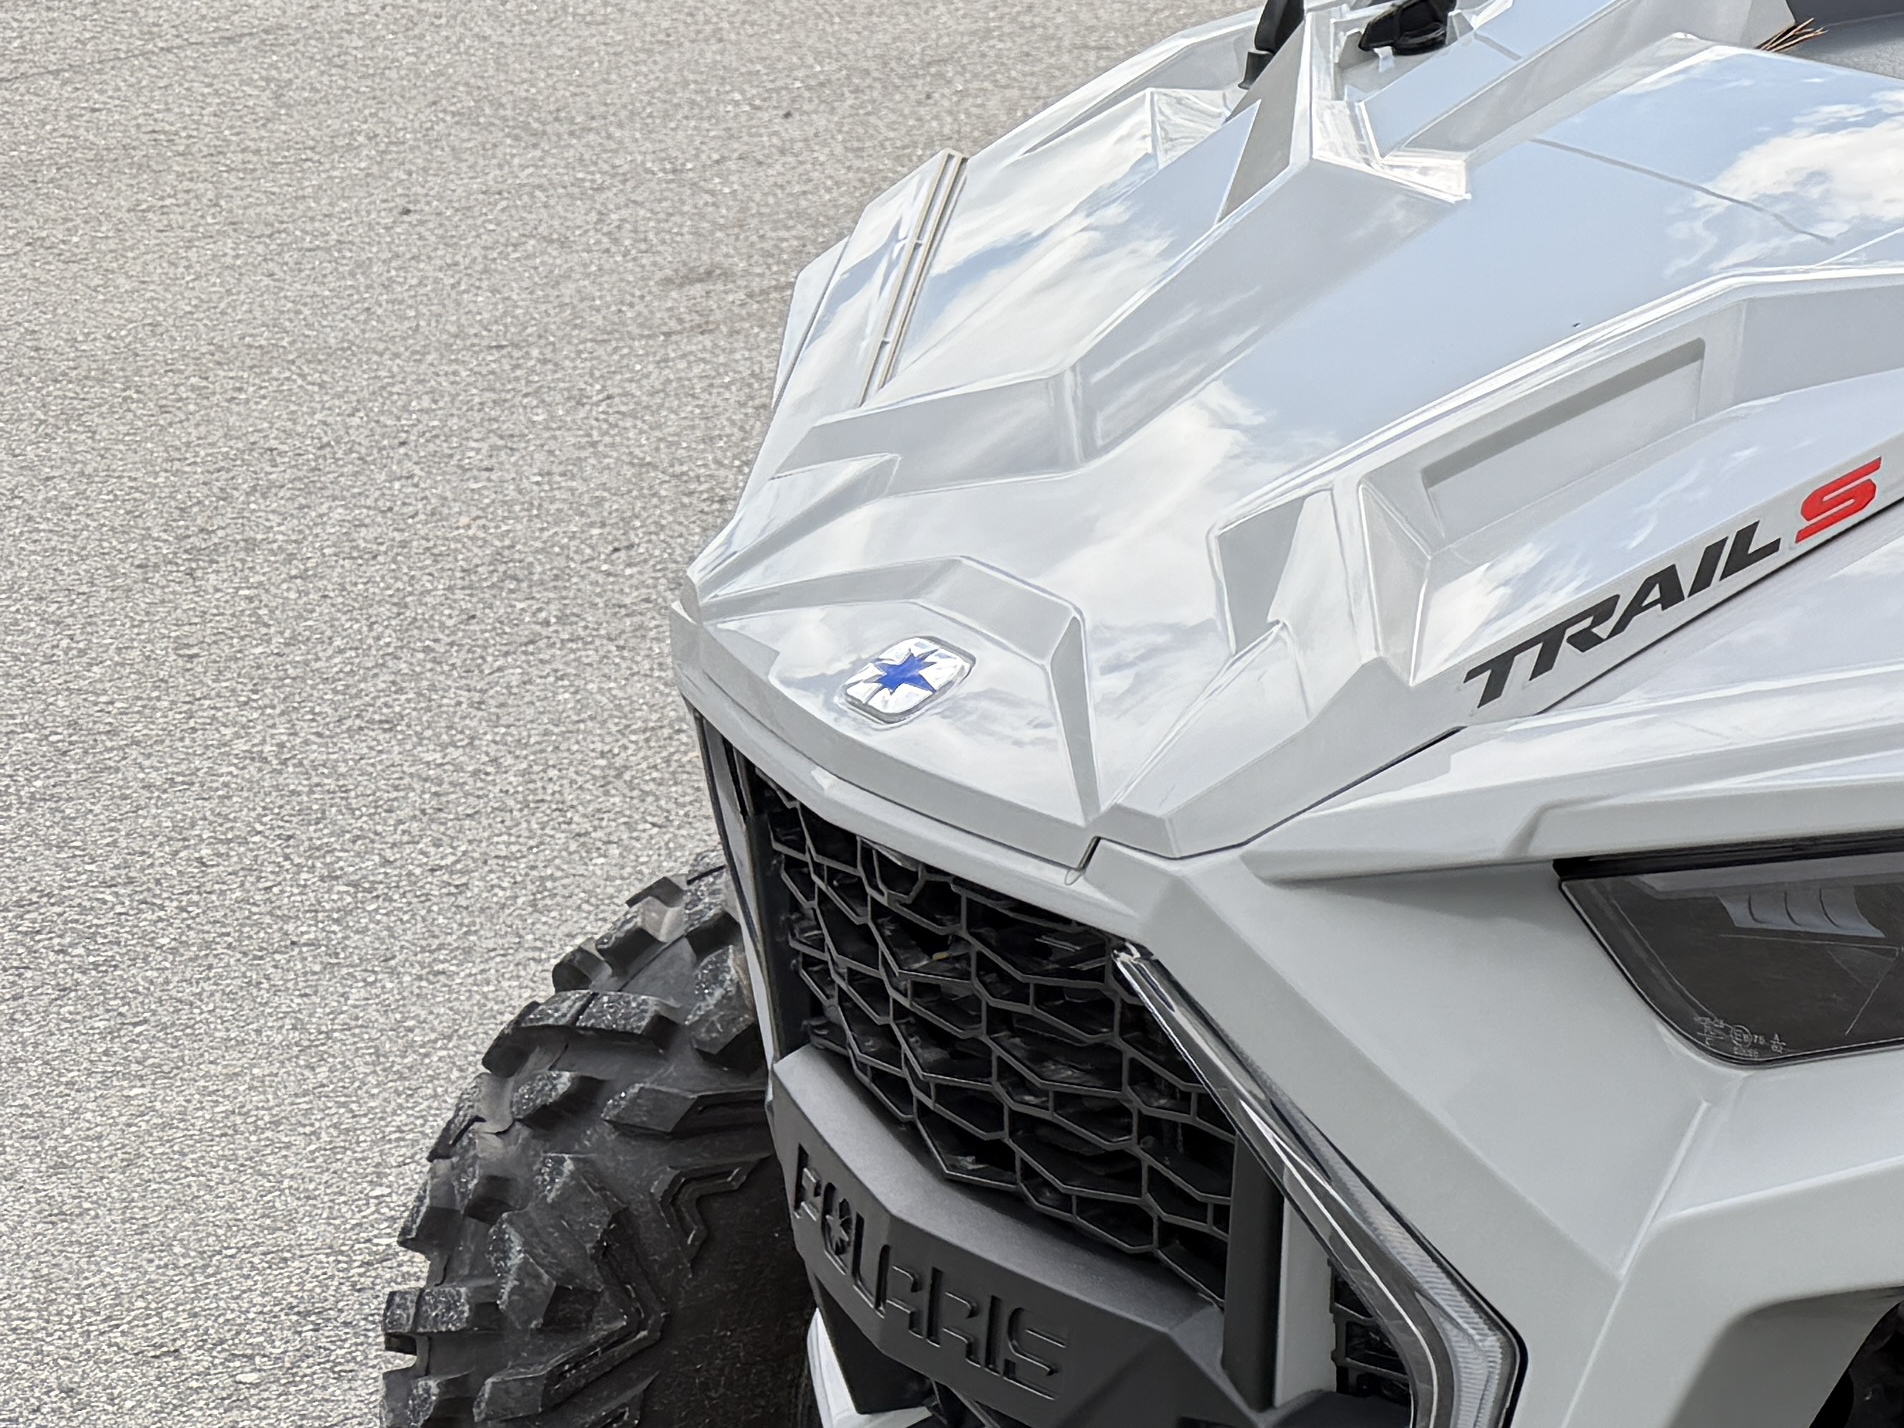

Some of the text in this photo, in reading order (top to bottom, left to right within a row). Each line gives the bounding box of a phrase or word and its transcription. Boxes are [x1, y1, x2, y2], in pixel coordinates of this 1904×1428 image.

[1463, 456, 1882, 709] TRAIL S
[794, 1143, 1066, 1400] POLARIS
